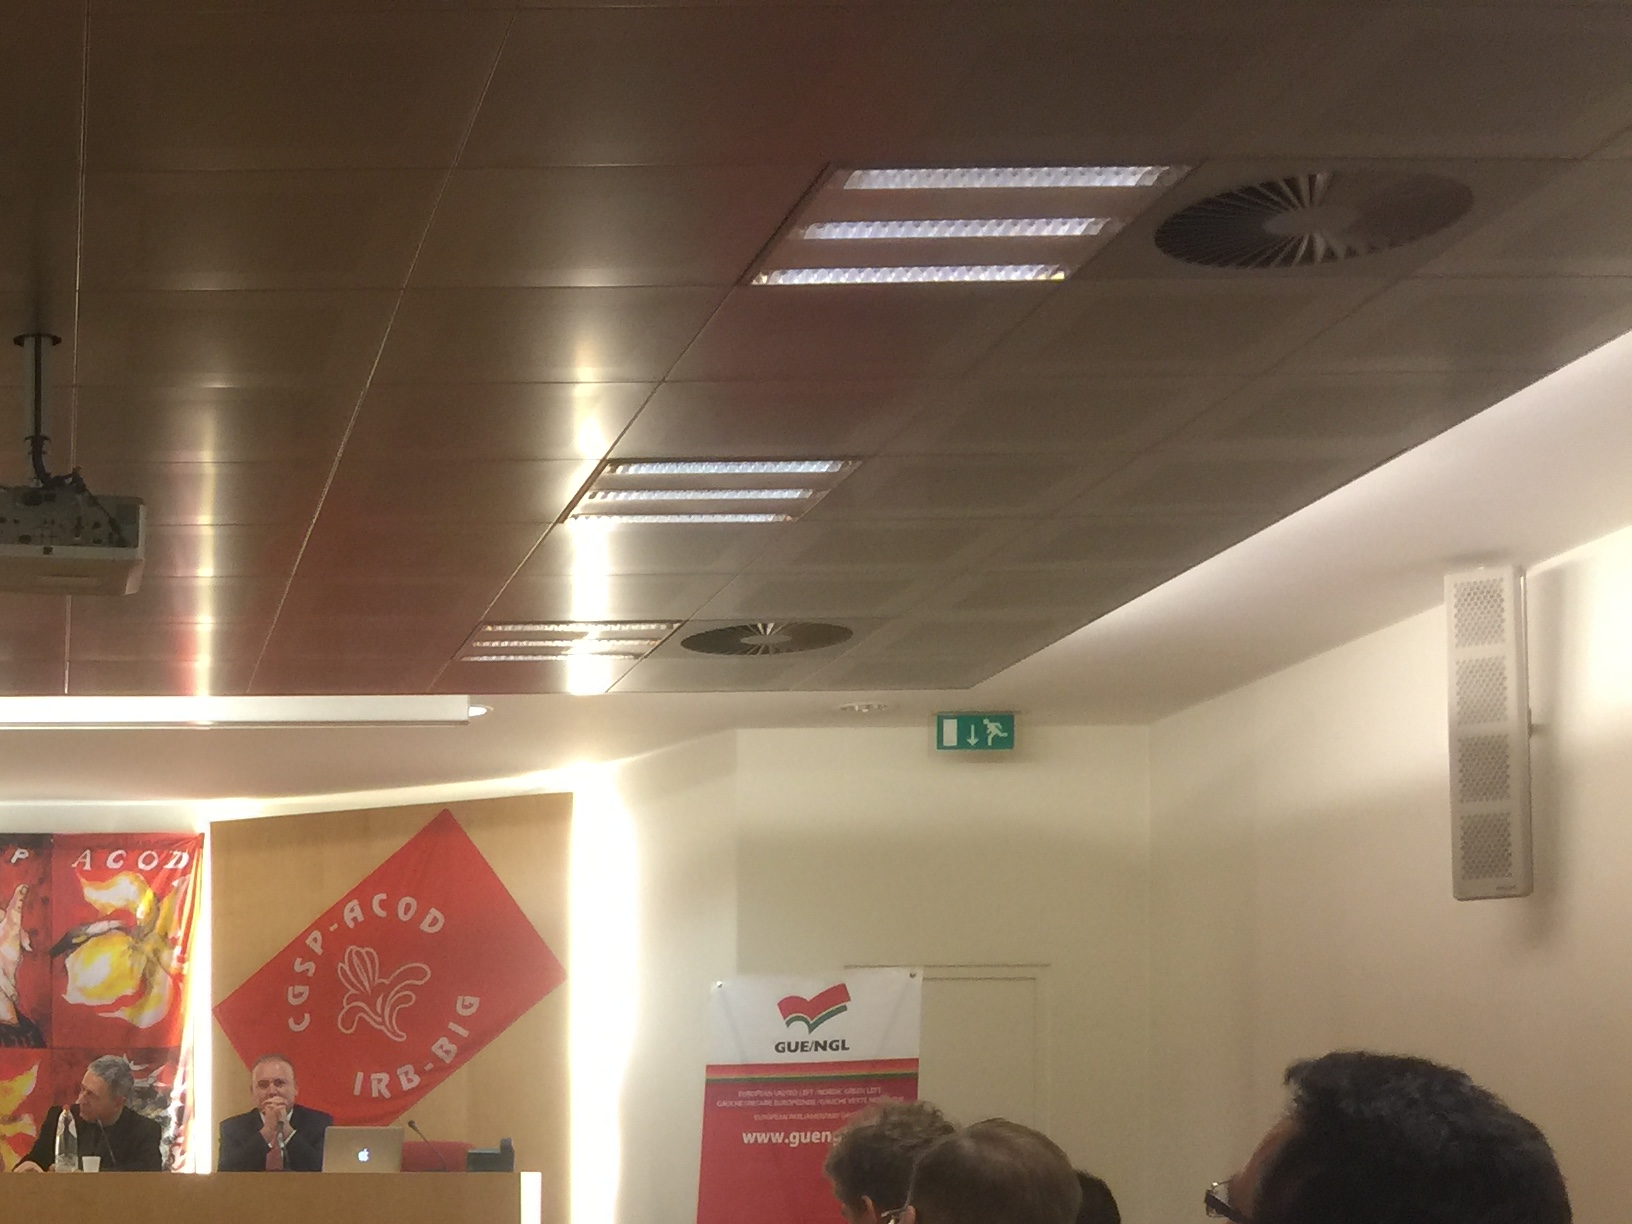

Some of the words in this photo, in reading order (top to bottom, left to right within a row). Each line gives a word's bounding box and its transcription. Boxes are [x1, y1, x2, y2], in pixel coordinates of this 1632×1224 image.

[71, 849, 190, 870] ACOD
[353, 995, 481, 1099] IRB-BIG
[774, 1039, 850, 1053] GUE/NGL
